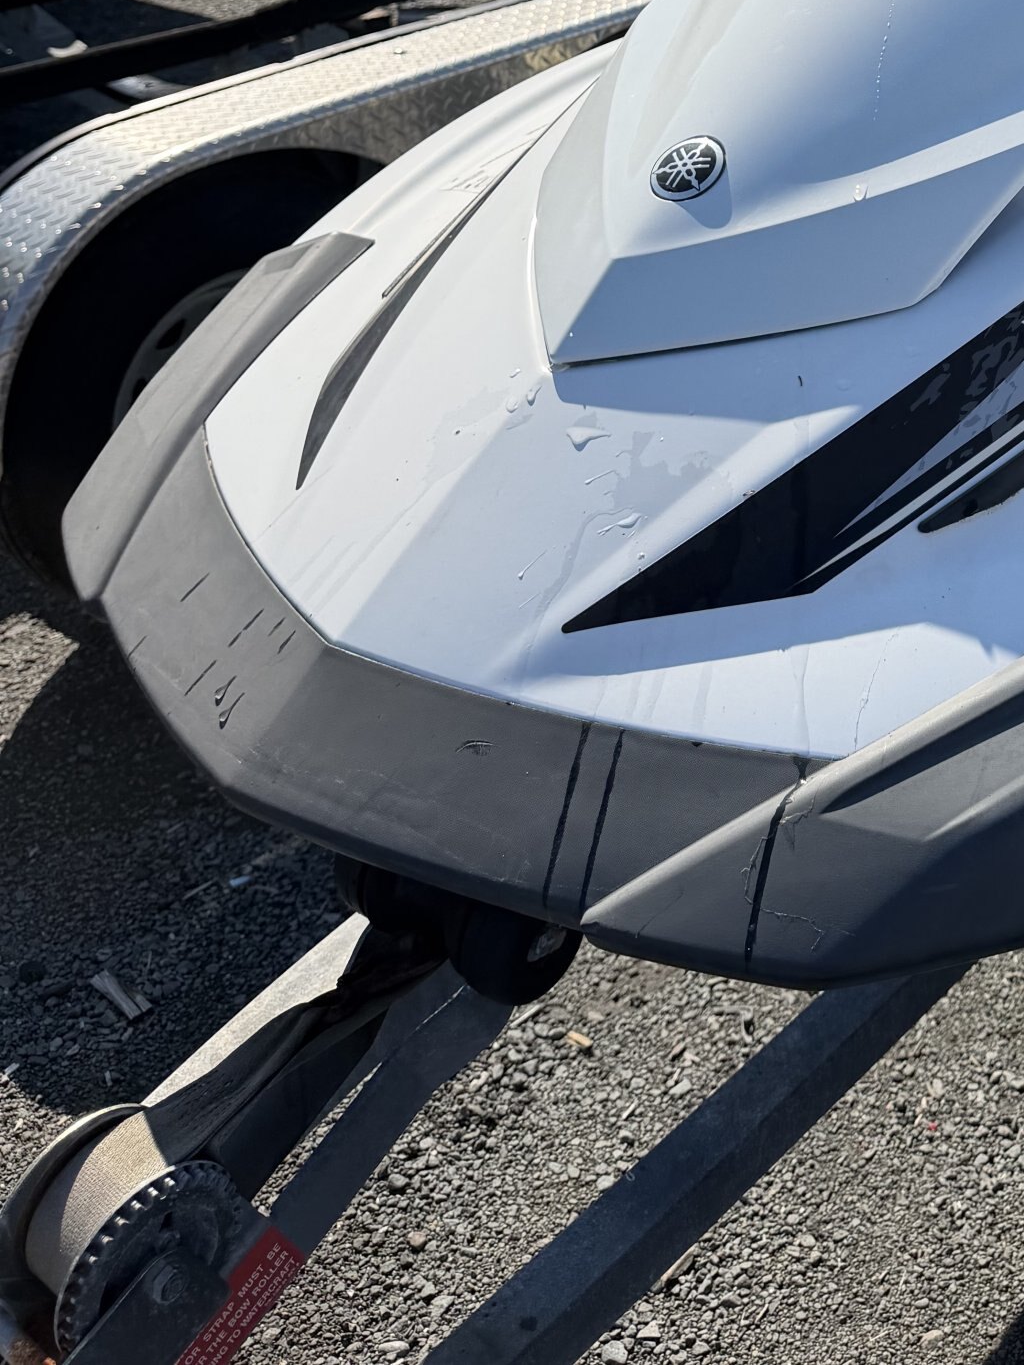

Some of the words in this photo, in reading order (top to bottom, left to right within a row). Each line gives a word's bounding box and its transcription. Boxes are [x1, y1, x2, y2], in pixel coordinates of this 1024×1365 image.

[203, 1301, 235, 1342] STRAP
[237, 1264, 264, 1298] MUST
[266, 1242, 281, 1260] BE
[206, 1329, 228, 1353] THE
[228, 1298, 251, 1327] BOW
[252, 1250, 289, 1296] ROLLER
[227, 1329, 241, 1343] TO
